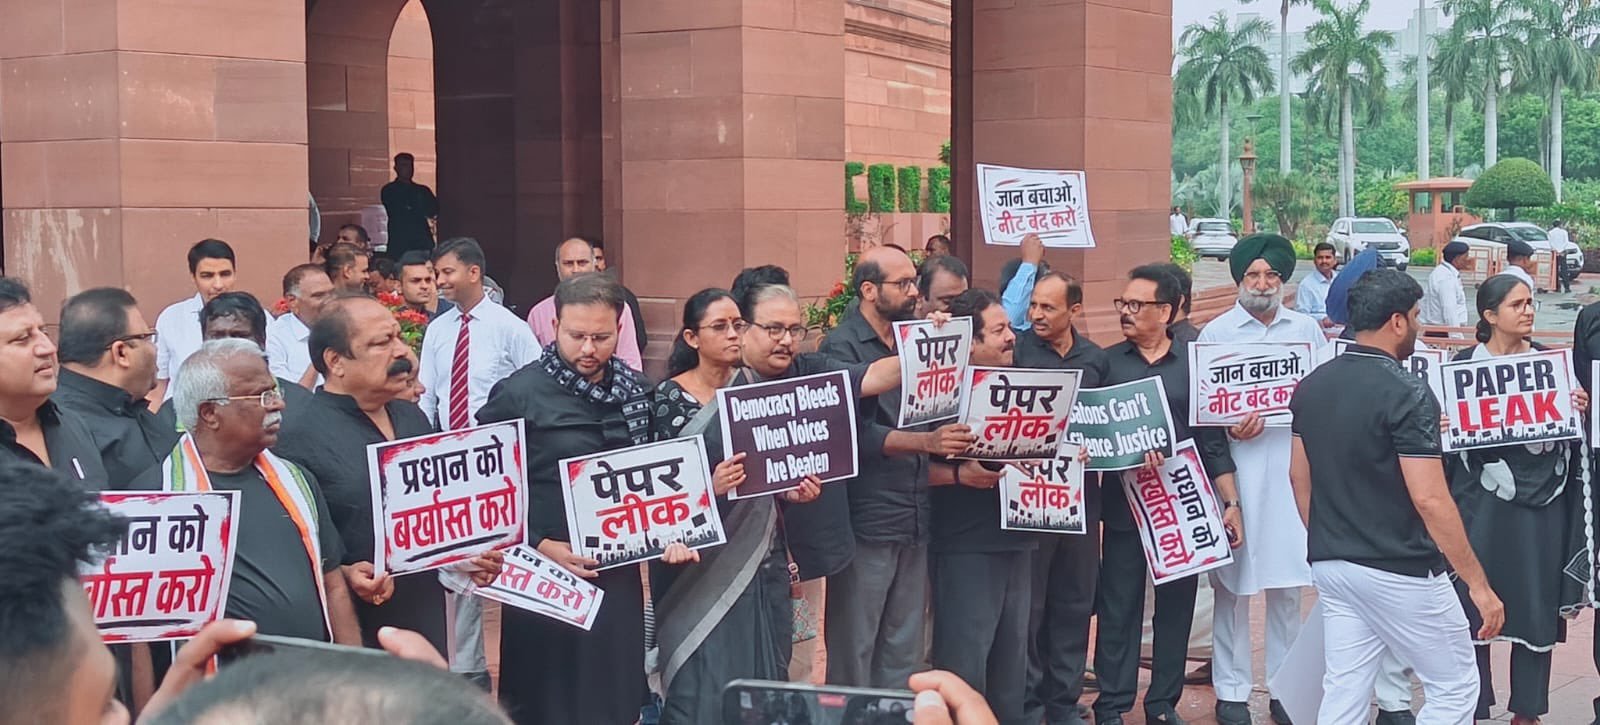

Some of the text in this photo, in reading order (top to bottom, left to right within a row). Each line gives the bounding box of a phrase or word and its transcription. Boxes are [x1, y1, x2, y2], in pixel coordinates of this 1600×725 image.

[995, 180, 1076, 207] जान बचाओ,
[996, 205, 1077, 234] नीट बंद करो
[915, 327, 962, 368] पेपर
[917, 361, 957, 400] लीक
[1209, 351, 1305, 384] जान बचाओ,
[1454, 359, 1556, 400] PAPER
[730, 381, 840, 422] Democracy Bleeds
[990, 375, 1063, 413] पेपर
[1109, 393, 1151, 422] Can't
[1208, 387, 1242, 414] नीट
[1245, 385, 1270, 408] बंद
[1457, 390, 1564, 432] LEAK
[752, 418, 829, 452] When Voices
[984, 408, 1054, 441] लीक
[1115, 425, 1167, 456] Justice
[399, 434, 503, 495] प्रधान को
[590, 457, 684, 504] पेपर
[766, 451, 829, 484] Are Beaten
[1019, 475, 1070, 509] लीक
[1168, 464, 1219, 550] प्रधान को
[168, 504, 209, 553] को
[391, 475, 516, 550] बर्खास्त करो
[596, 493, 690, 539] लीक
[1160, 528, 1195, 568] करो
[156, 555, 215, 613] करो
[537, 575, 585, 610] करो
